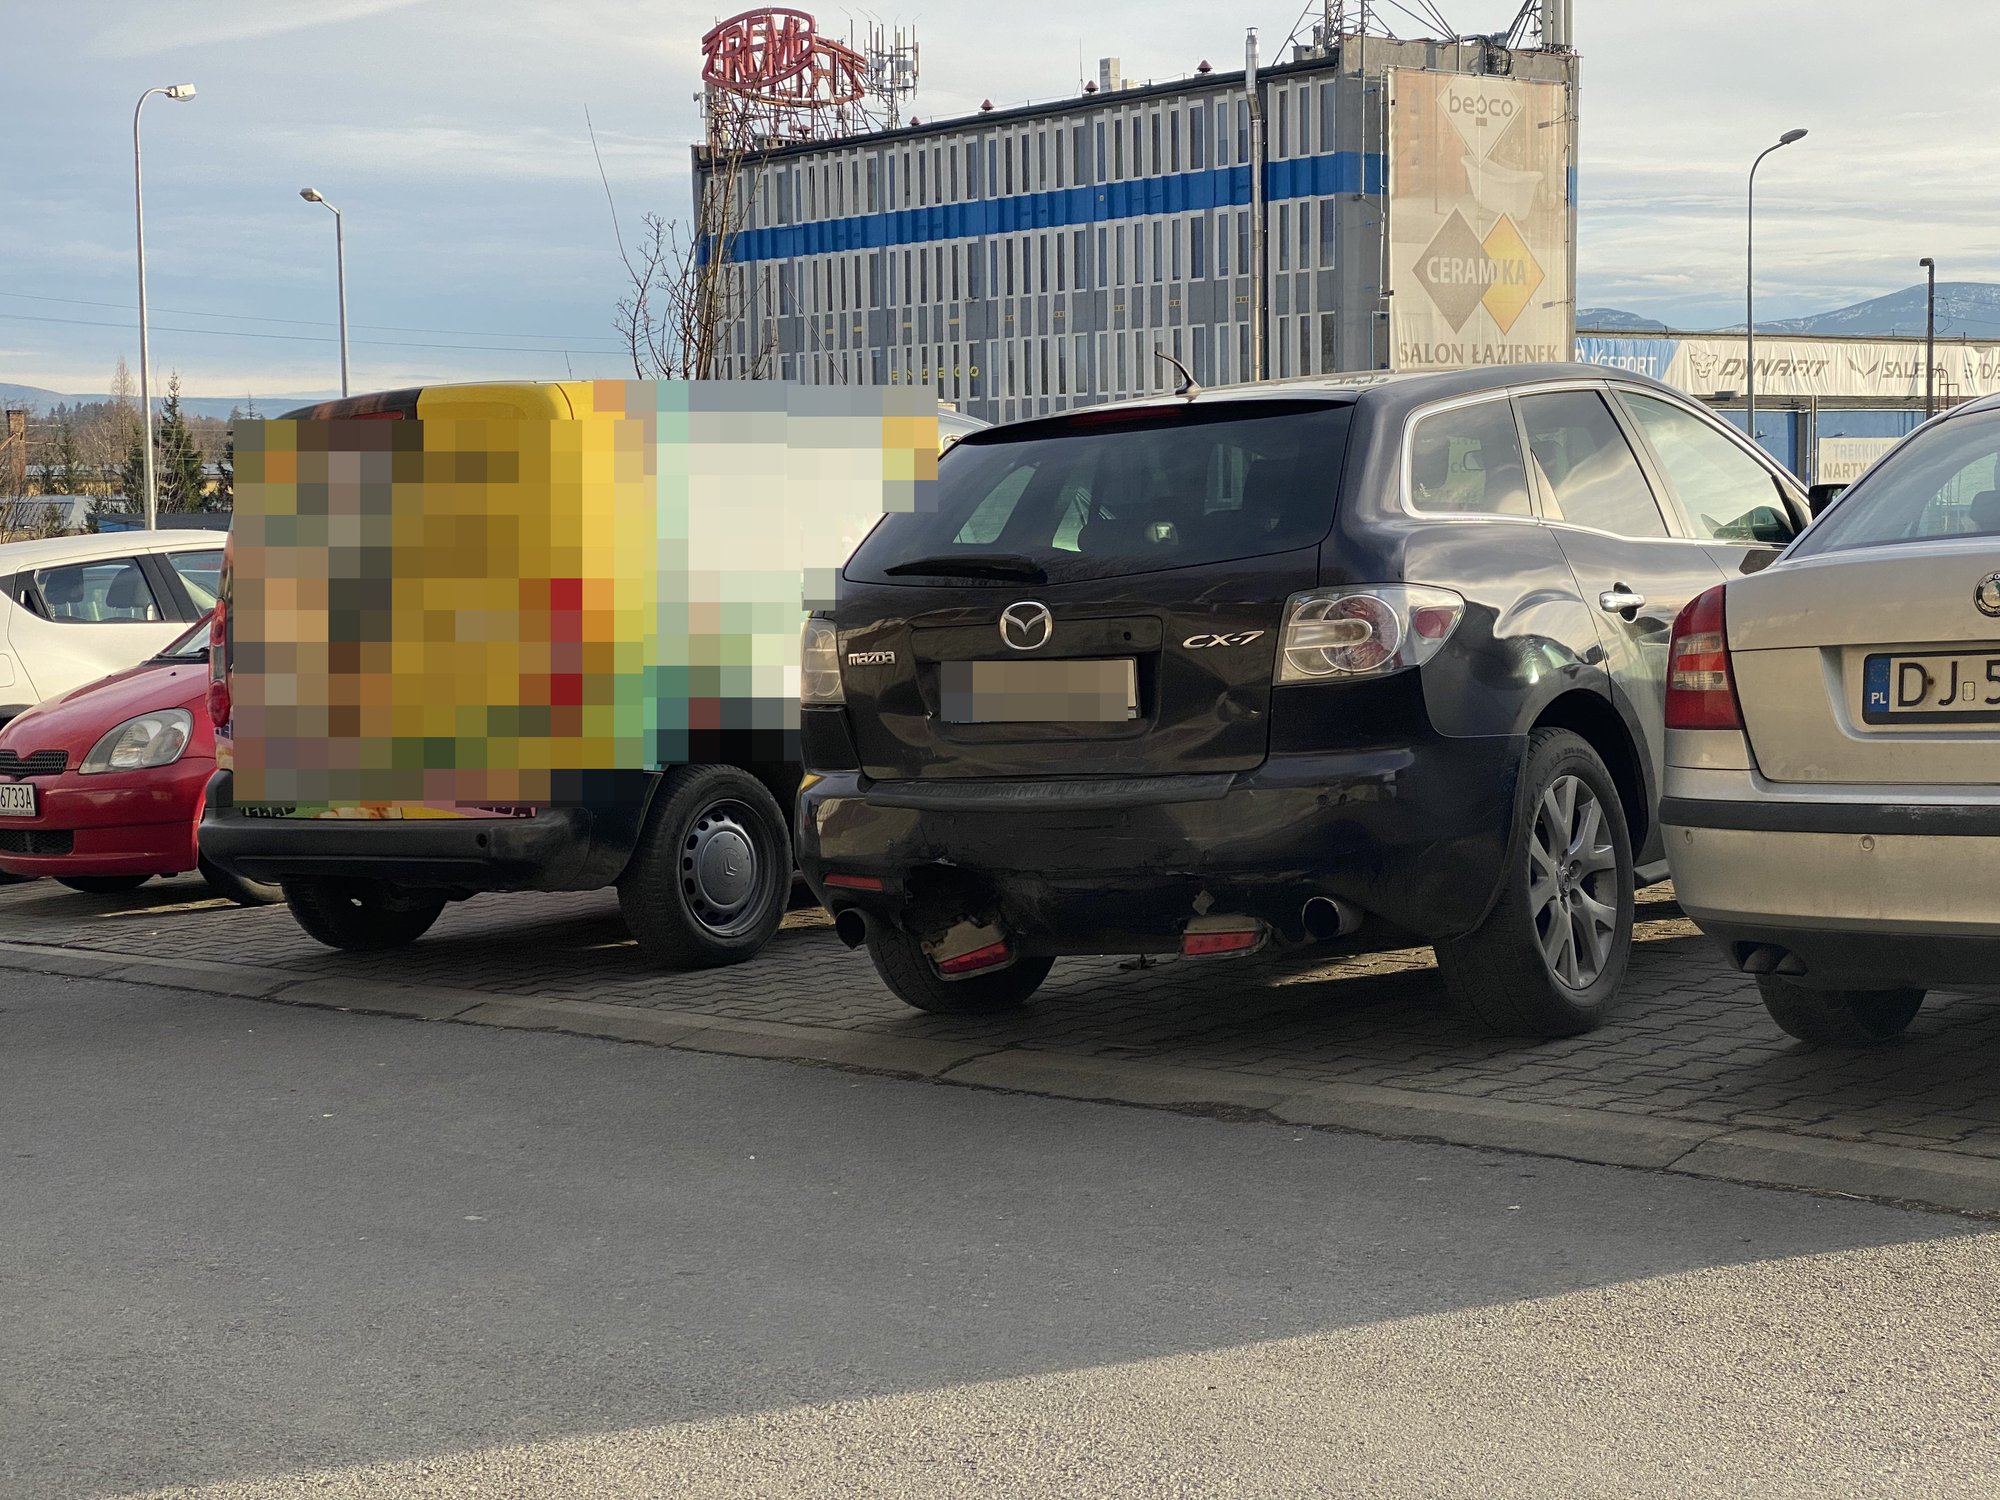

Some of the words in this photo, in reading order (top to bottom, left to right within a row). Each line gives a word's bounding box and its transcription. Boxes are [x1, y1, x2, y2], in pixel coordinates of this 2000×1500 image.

[1399, 342, 1464, 365] SALON
[1471, 343, 1558, 365] ŁAZIENEK
[1882, 361, 1946, 379] SALEA
[1182, 630, 1265, 649] CX-7
[1871, 692, 1887, 705] PL
